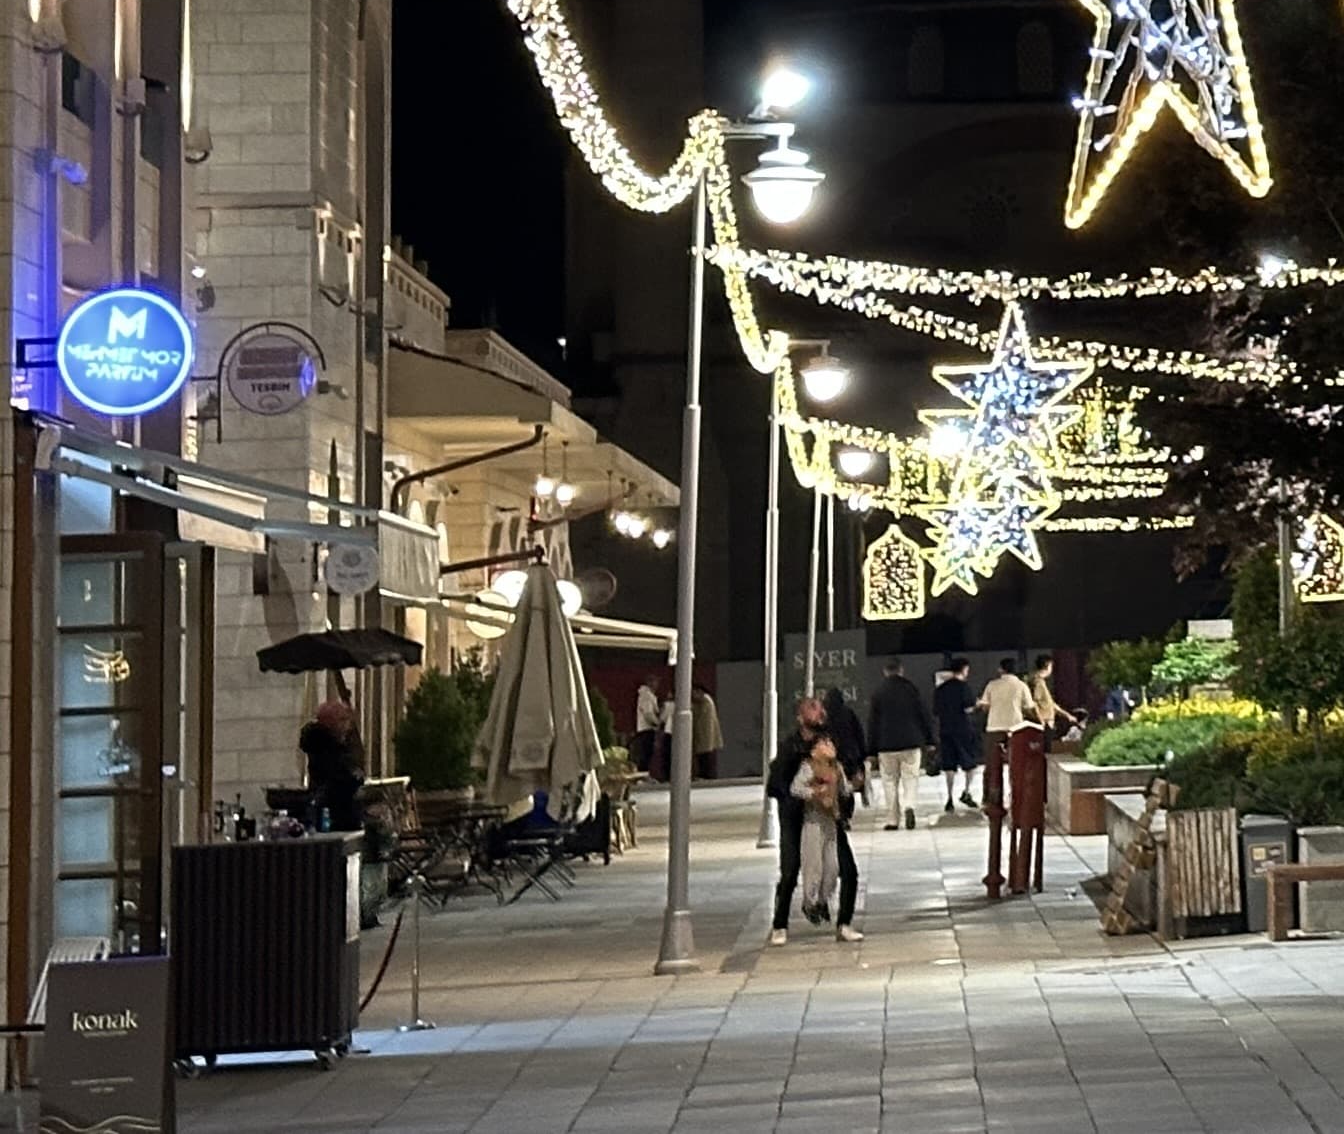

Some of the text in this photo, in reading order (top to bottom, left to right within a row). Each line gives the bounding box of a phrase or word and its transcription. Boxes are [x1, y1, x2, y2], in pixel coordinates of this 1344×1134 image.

[107, 305, 148, 344] M
[793, 649, 856, 669] SYER
[73, 1009, 138, 1031] konak
